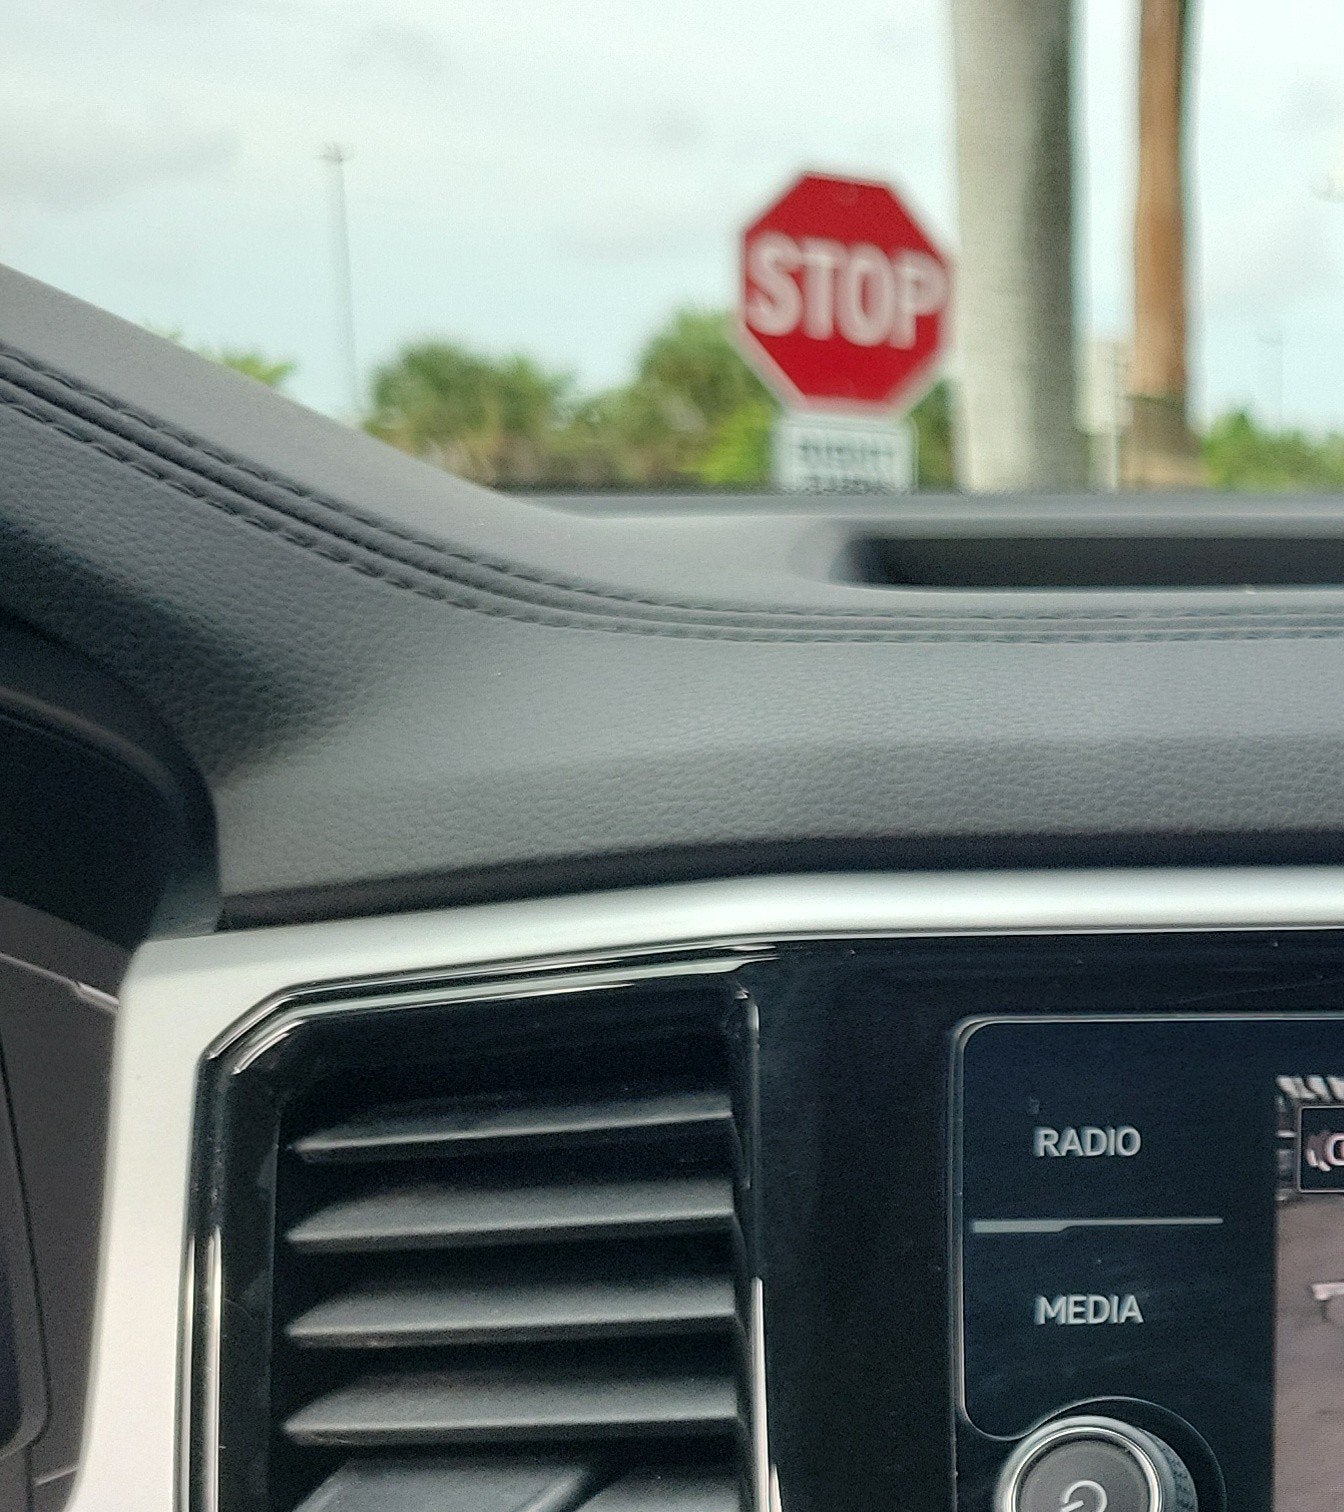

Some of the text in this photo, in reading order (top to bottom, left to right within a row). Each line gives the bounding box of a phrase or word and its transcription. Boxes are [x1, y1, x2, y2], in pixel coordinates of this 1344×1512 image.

[747, 230, 950, 350] STOP
[1034, 1126, 1142, 1157] RADIO
[1034, 1295, 1144, 1325] MEDIA
